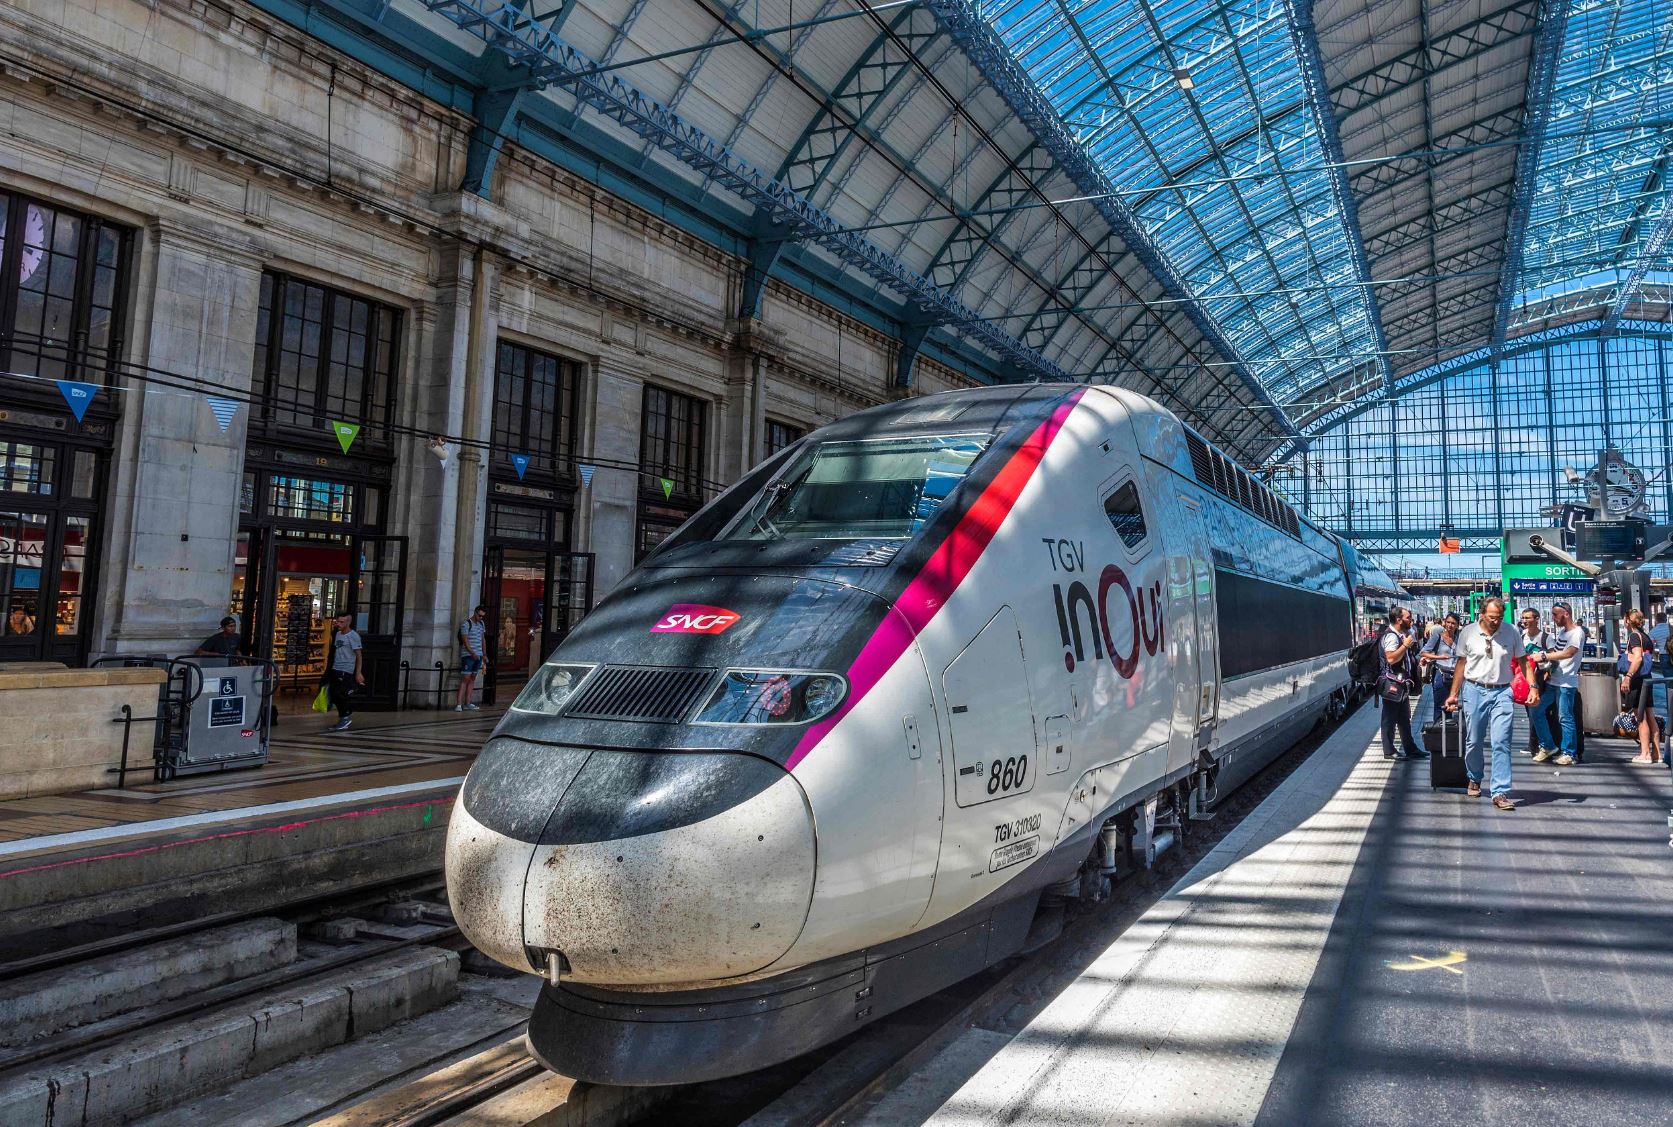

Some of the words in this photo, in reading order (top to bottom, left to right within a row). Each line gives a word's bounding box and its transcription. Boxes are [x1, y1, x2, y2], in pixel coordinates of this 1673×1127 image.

[1042, 538, 1083, 572] TGV
[657, 614, 734, 630] SNCF
[987, 754, 1027, 795] 860
[994, 821, 1014, 843] TGV
